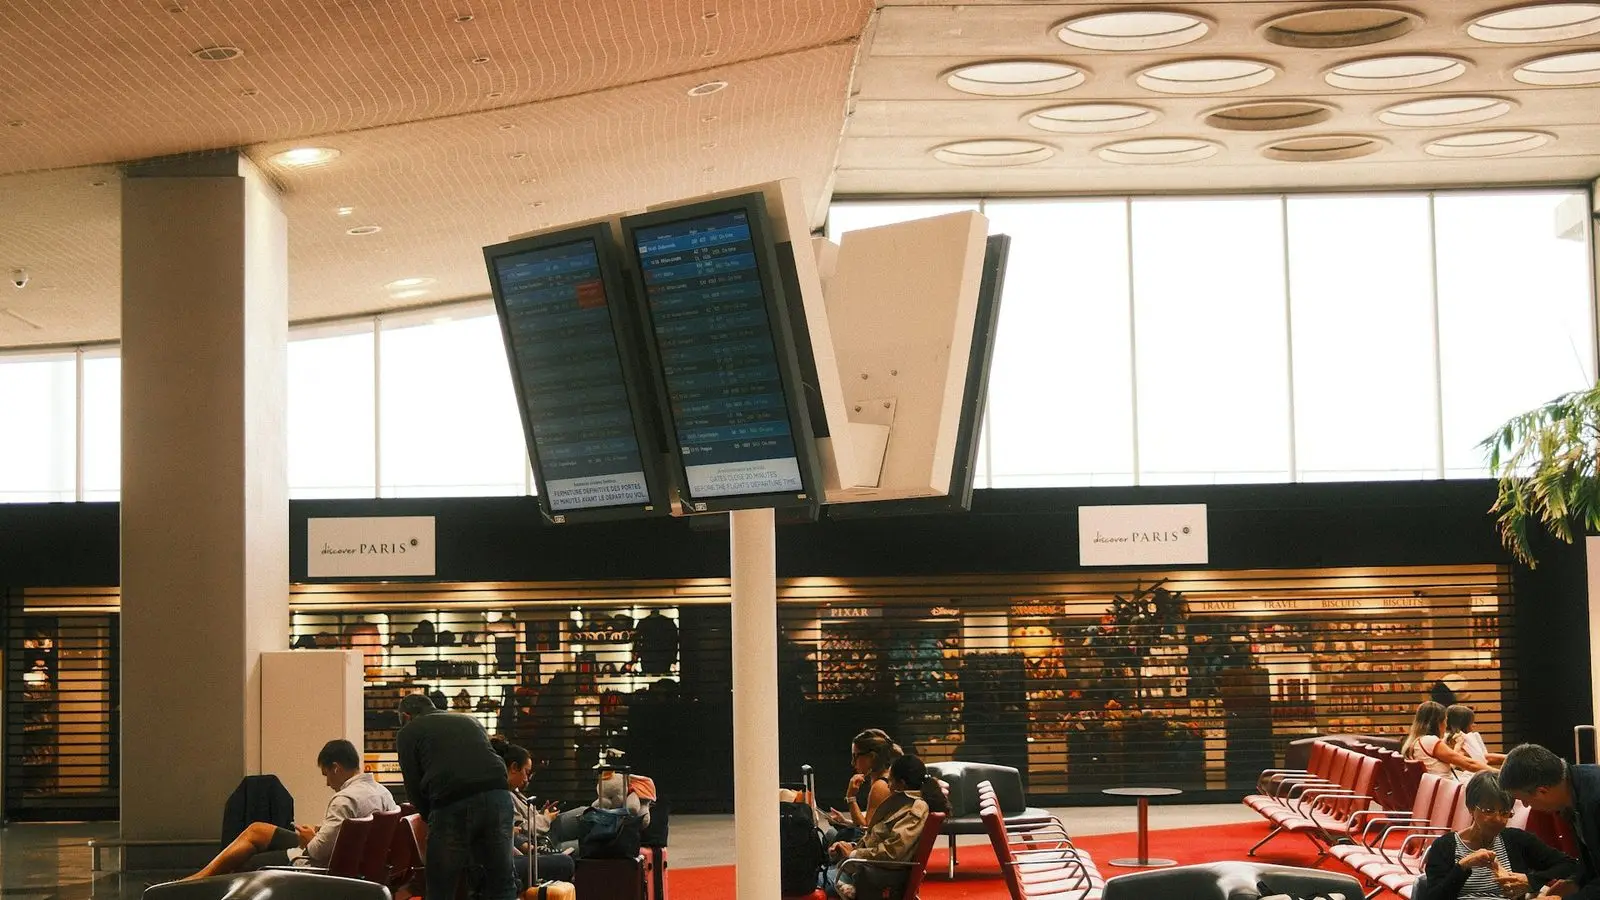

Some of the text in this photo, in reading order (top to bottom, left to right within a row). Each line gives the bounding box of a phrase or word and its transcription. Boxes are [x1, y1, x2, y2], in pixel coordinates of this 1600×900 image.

[554, 488, 581, 497] FERMETURE
[1093, 531, 1178, 543] discover PARIS
[321, 543, 406, 555] discover PARIS
[1201, 601, 1236, 610] TRAVEL
[1264, 600, 1297, 608] TRAVEL
[1321, 600, 1361, 608] BISCUITS
[1383, 599, 1423, 607] BISCUITS
[831, 608, 869, 617] PIXAR
[930, 606, 960, 616] Disney
